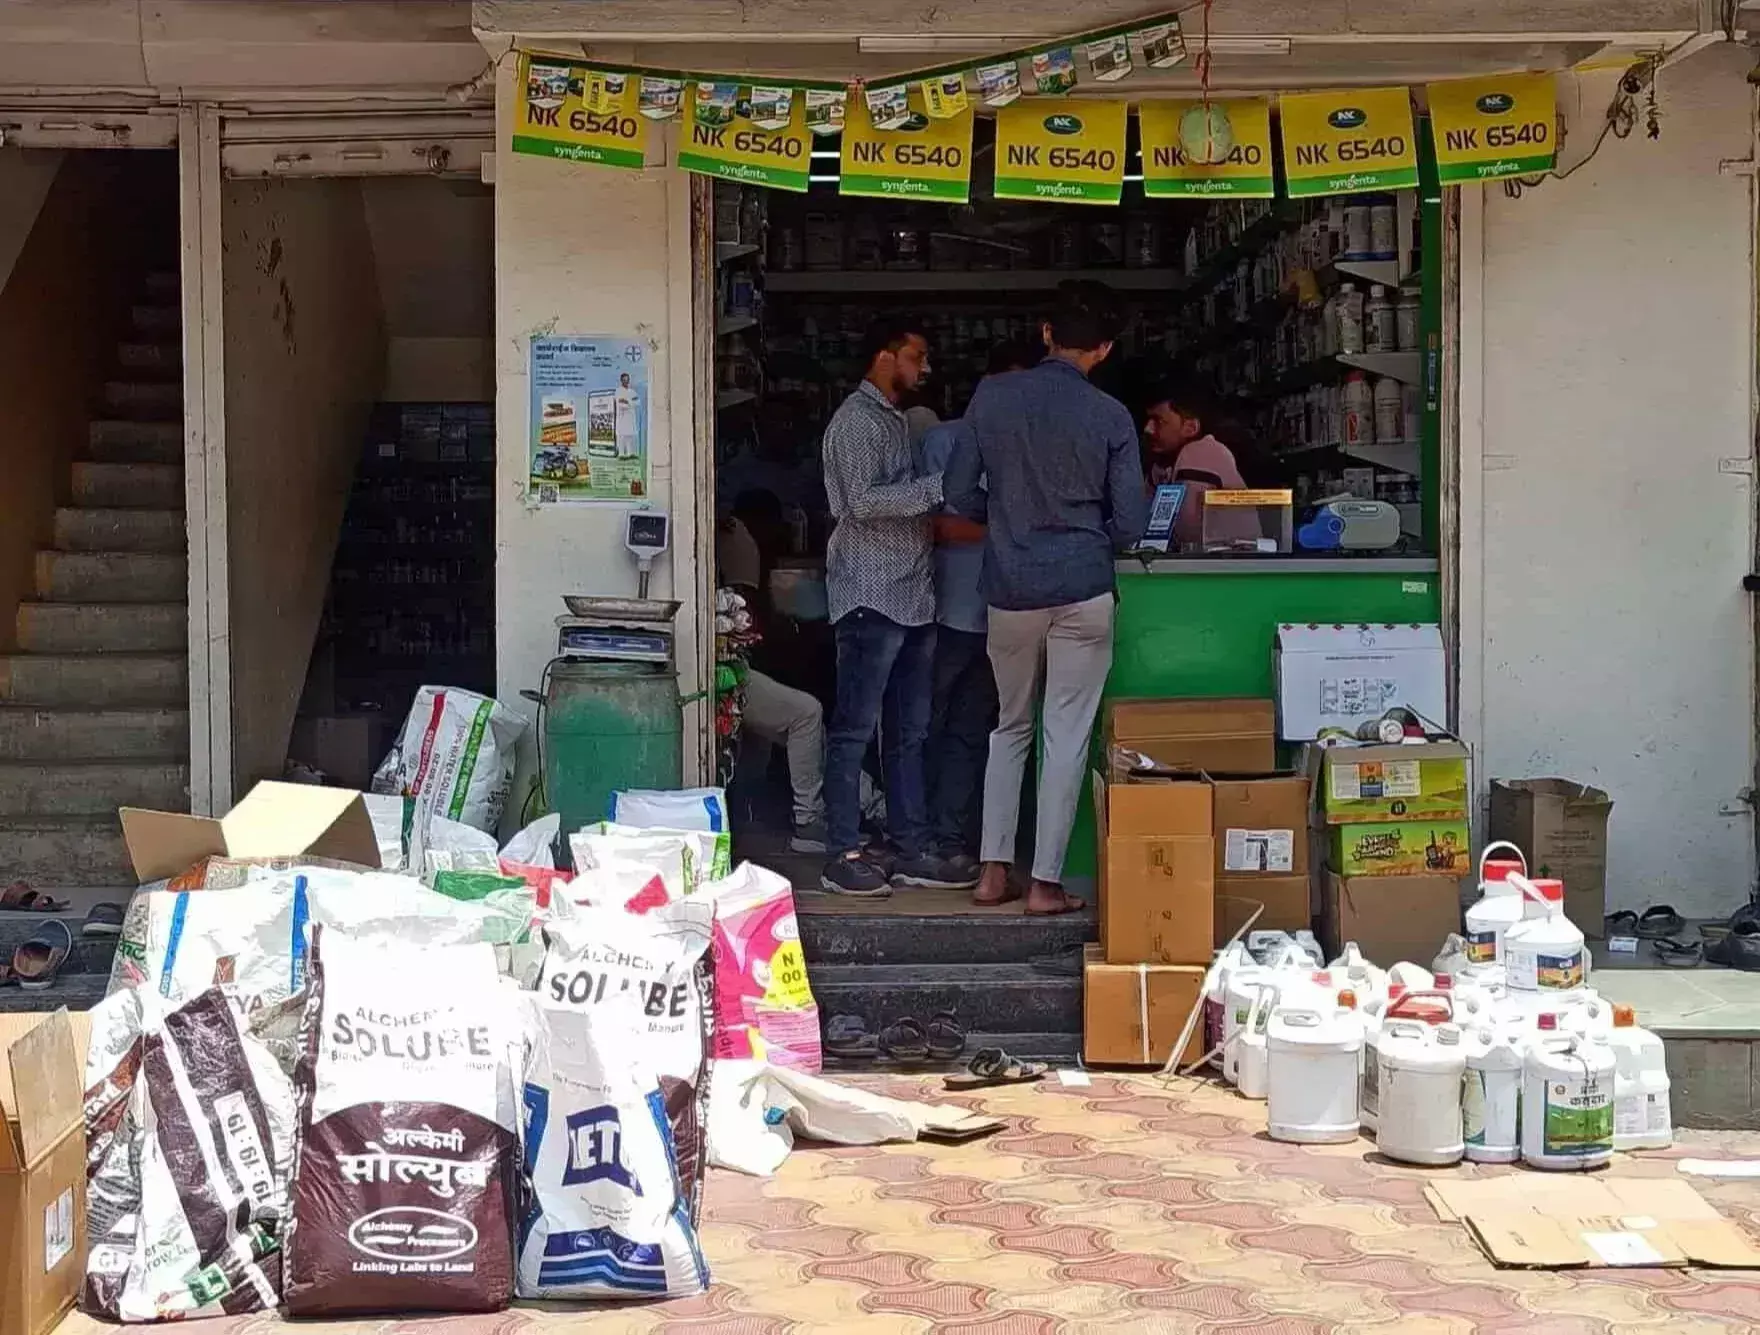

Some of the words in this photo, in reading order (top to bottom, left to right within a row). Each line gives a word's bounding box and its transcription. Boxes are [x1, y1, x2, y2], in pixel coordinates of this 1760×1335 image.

[527, 106, 559, 129] NK
[569, 113, 638, 139] 6540
[1053, 116, 1072, 128] NK
[693, 125, 725, 147] NK
[734, 131, 802, 158] 6540
[1445, 129, 1480, 151] NK
[1486, 122, 1547, 147] 6540
[853, 142, 886, 164] NK
[895, 144, 962, 167] 6540
[1007, 144, 1040, 167] NK
[1049, 147, 1116, 171] 6540
[1154, 147, 1185, 168] NK
[1296, 144, 1329, 166] NK
[1337, 136, 1405, 162] 6540
[580, 949, 675, 974] ALCHEY
[782, 951, 795, 968] N
[355, 1006, 454, 1028] ALCHE
[352, 1262, 398, 1275] Linking
[400, 1262, 427, 1272] Labs
[429, 1262, 442, 1272] to
[444, 1262, 474, 1272] Land
